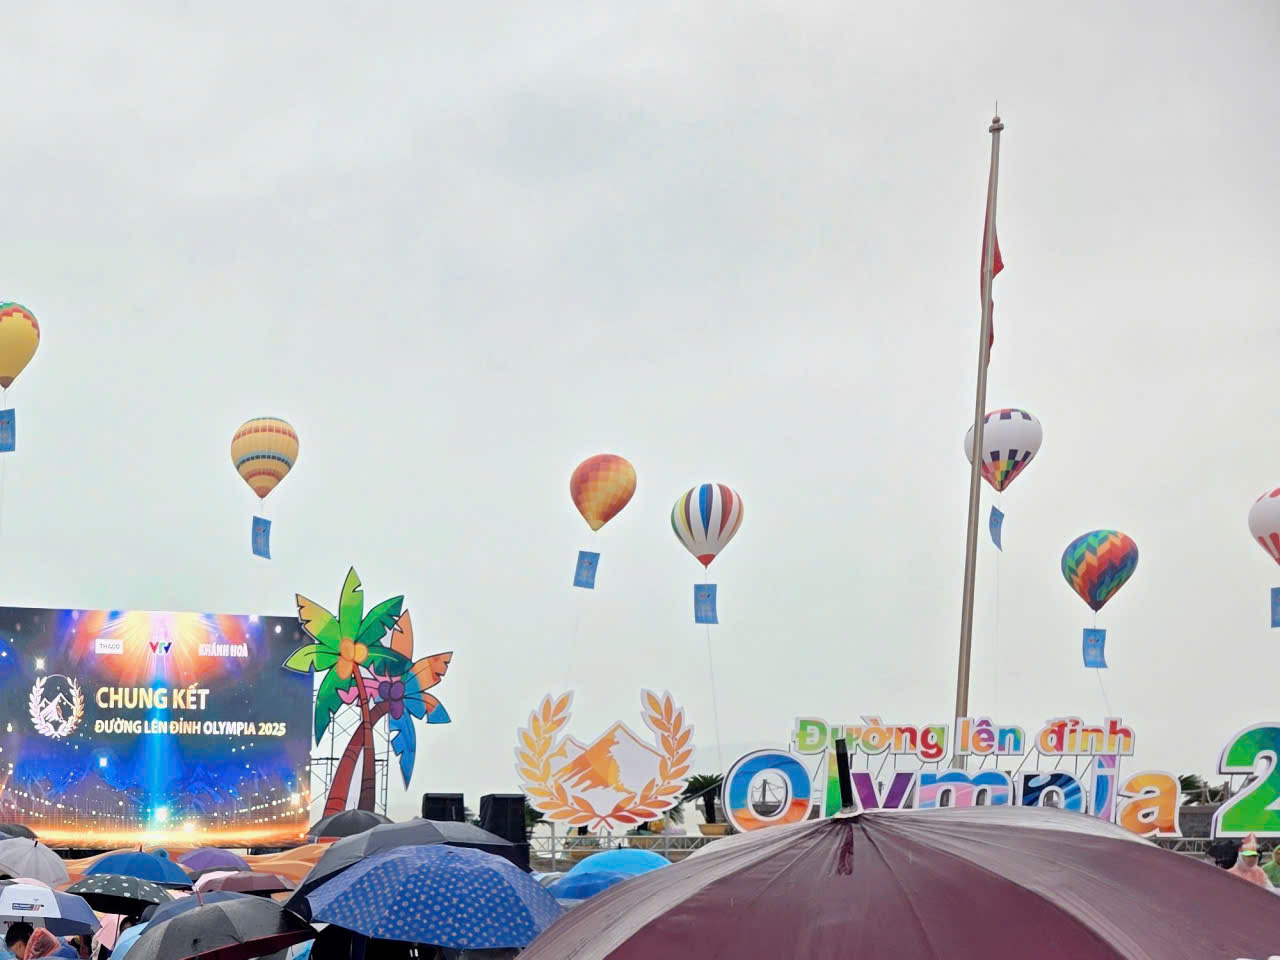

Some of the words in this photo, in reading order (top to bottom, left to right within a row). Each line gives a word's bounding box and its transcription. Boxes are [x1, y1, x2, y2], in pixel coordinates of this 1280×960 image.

[149, 641, 172, 654] VTV
[199, 642, 229, 657] KHÁNH
[95, 687, 168, 709] CHUNG
[172, 683, 210, 710] KẾT
[94, 718, 142, 734] ĐƯỜNG
[144, 719, 168, 734] LÊN
[169, 717, 201, 735] ĐỈNH
[203, 720, 256, 736] OLYMPIA
[258, 722, 287, 737] 2025
[793, 716, 948, 762] Đường
[955, 717, 1025, 755] lên
[1035, 717, 1135, 756] đỉnh
